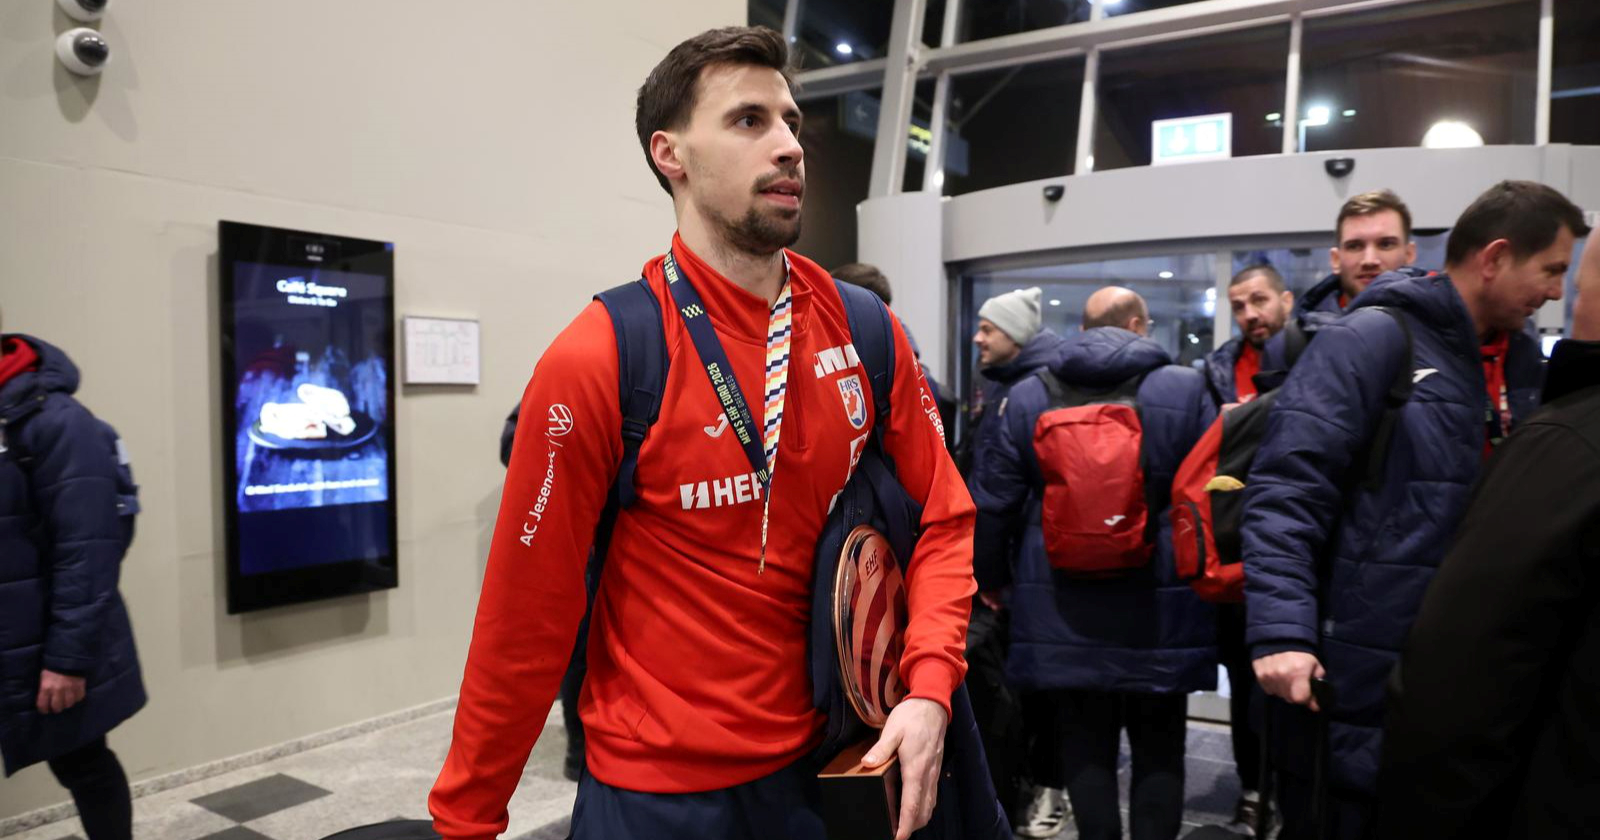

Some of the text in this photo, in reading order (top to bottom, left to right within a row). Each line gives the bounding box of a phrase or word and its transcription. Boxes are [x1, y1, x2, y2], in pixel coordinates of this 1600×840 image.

[707, 362, 725, 385] 2026
[839, 377, 859, 392] HRS
[717, 384, 734, 406] EURO
[725, 374, 745, 408] GREATNESS
[726, 406, 740, 421] EHF
[520, 522, 538, 547] AC
[865, 548, 879, 575] EHF
